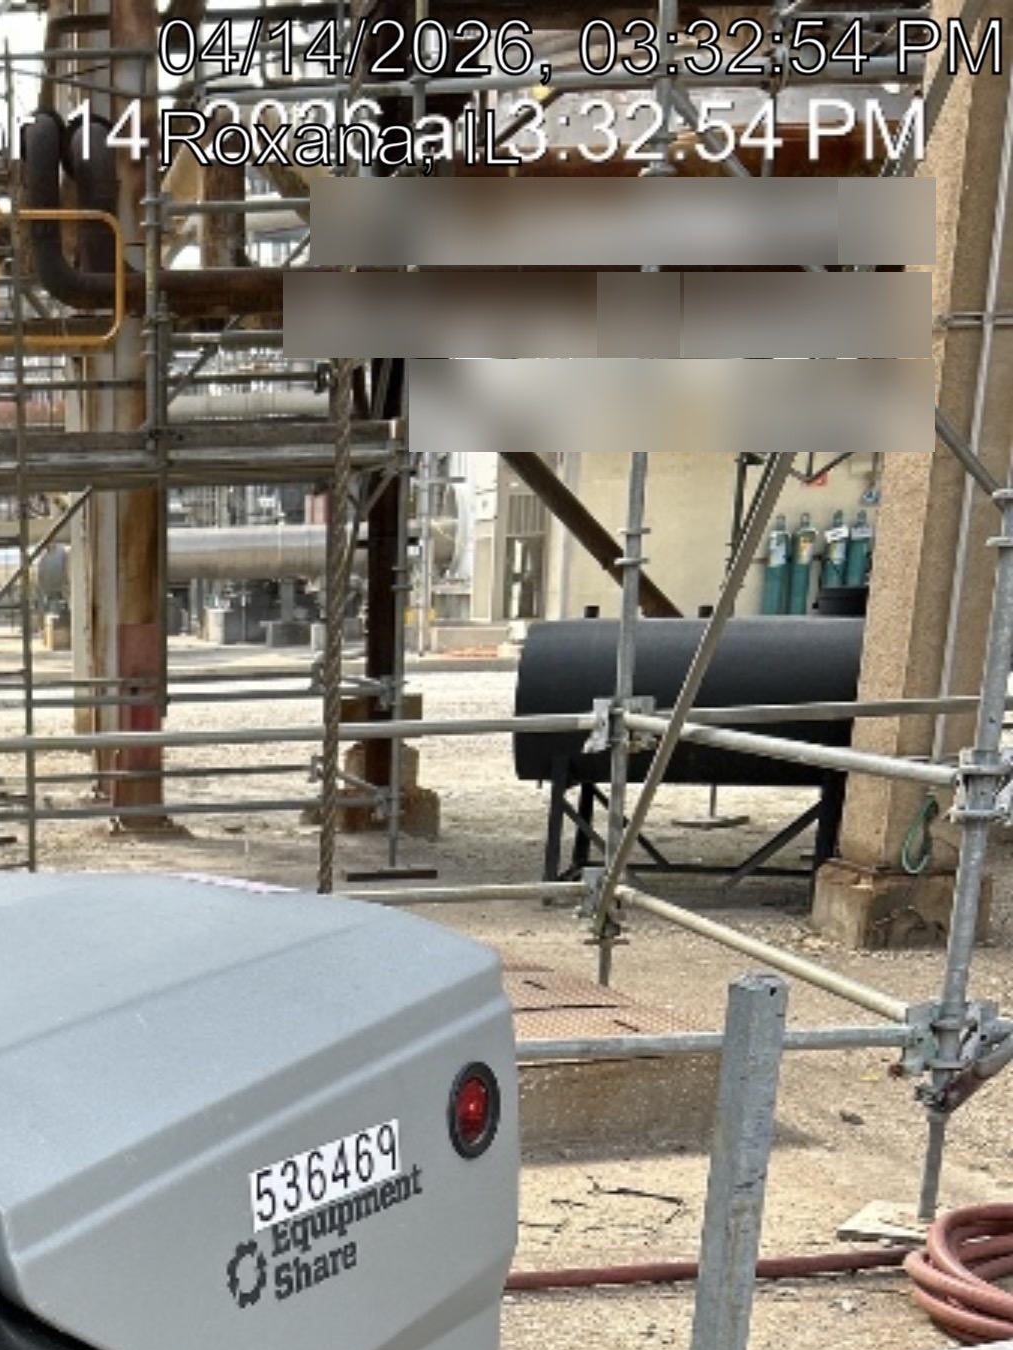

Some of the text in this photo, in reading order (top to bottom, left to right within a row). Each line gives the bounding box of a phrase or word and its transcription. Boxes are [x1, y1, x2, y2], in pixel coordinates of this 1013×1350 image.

[254, 1123, 398, 1223] 536469
[271, 1163, 424, 1258] Equipment
[274, 1241, 358, 1301] Share
